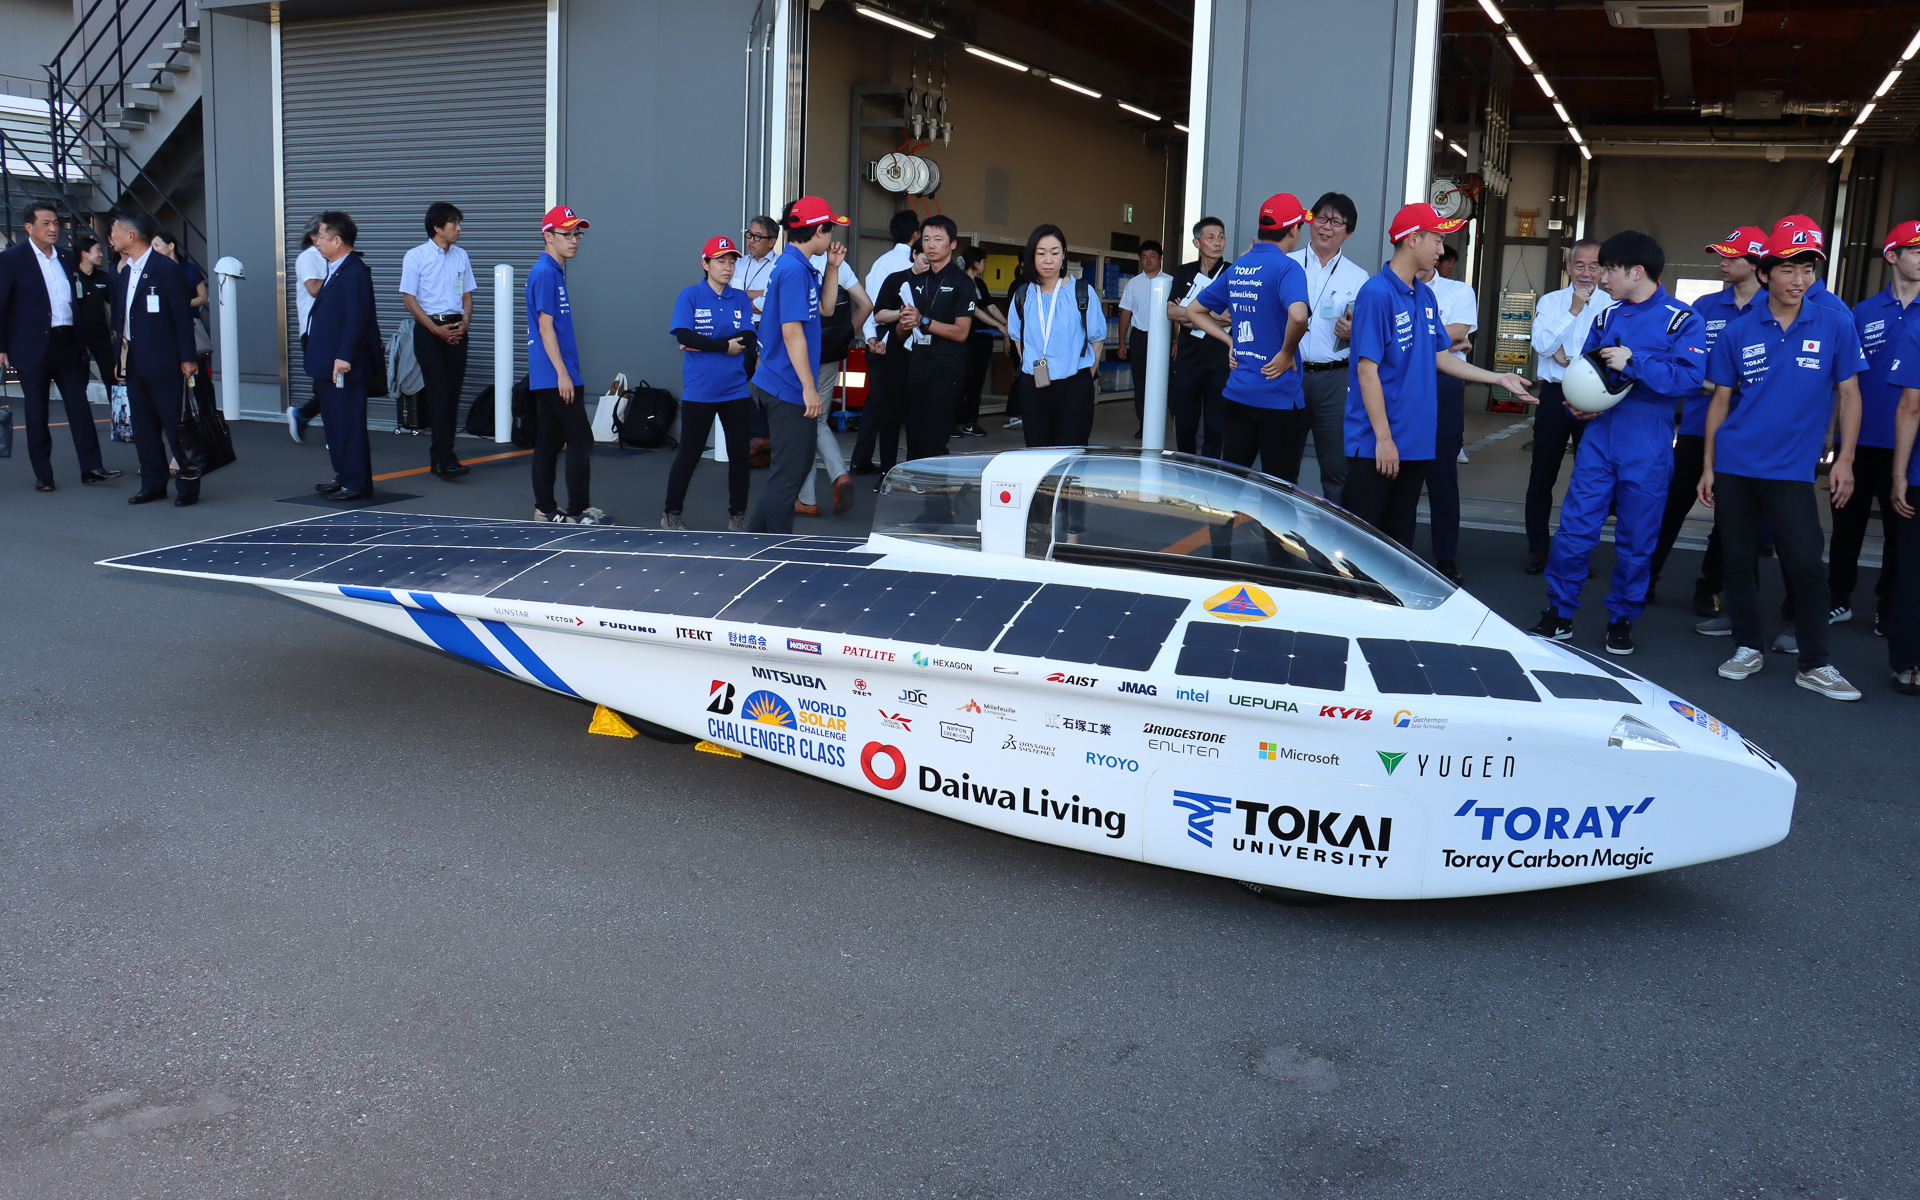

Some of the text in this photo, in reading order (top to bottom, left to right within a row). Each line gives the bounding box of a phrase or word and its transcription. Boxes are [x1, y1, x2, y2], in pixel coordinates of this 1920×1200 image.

[493, 607, 530, 618] SUNSTAR
[545, 614, 574, 624] VECTOR
[599, 620, 657, 634] FURUNO
[675, 626, 713, 641] JTEKT
[730, 642, 757, 650] NOMURA
[842, 645, 896, 662] PATLITE
[933, 658, 973, 671] HEXAGON
[751, 665, 827, 691] MITSUBA
[1064, 675, 1099, 688] AIST
[898, 689, 928, 706] JDC
[1117, 681, 1158, 697] JMAG
[1176, 685, 1209, 703] intel
[797, 697, 847, 718] WORLD
[983, 703, 1016, 714] Millefeuille
[1228, 694, 1299, 713] UEPURA
[799, 711, 847, 732] SOLAR
[1319, 705, 1374, 721] KYB
[799, 724, 847, 742] CHALLENGE
[1062, 717, 1112, 736] 石塚工業
[1142, 722, 1227, 744] BRIDGESTONE
[708, 717, 846, 768] CHALLENGER CLASS
[1019, 741, 1056, 752] DASSAULT
[1148, 738, 1219, 758] ENLITEN
[1086, 751, 1139, 772] RYOYO
[1280, 747, 1340, 766] Microsoft
[1418, 754, 1516, 778] YUGEN
[918, 765, 1126, 839] Daiwa Living
[1235, 799, 1393, 852] TOKAI
[1232, 837, 1389, 869] UNIVERSITY
[1441, 846, 1654, 873] Toray Carbon Magic
